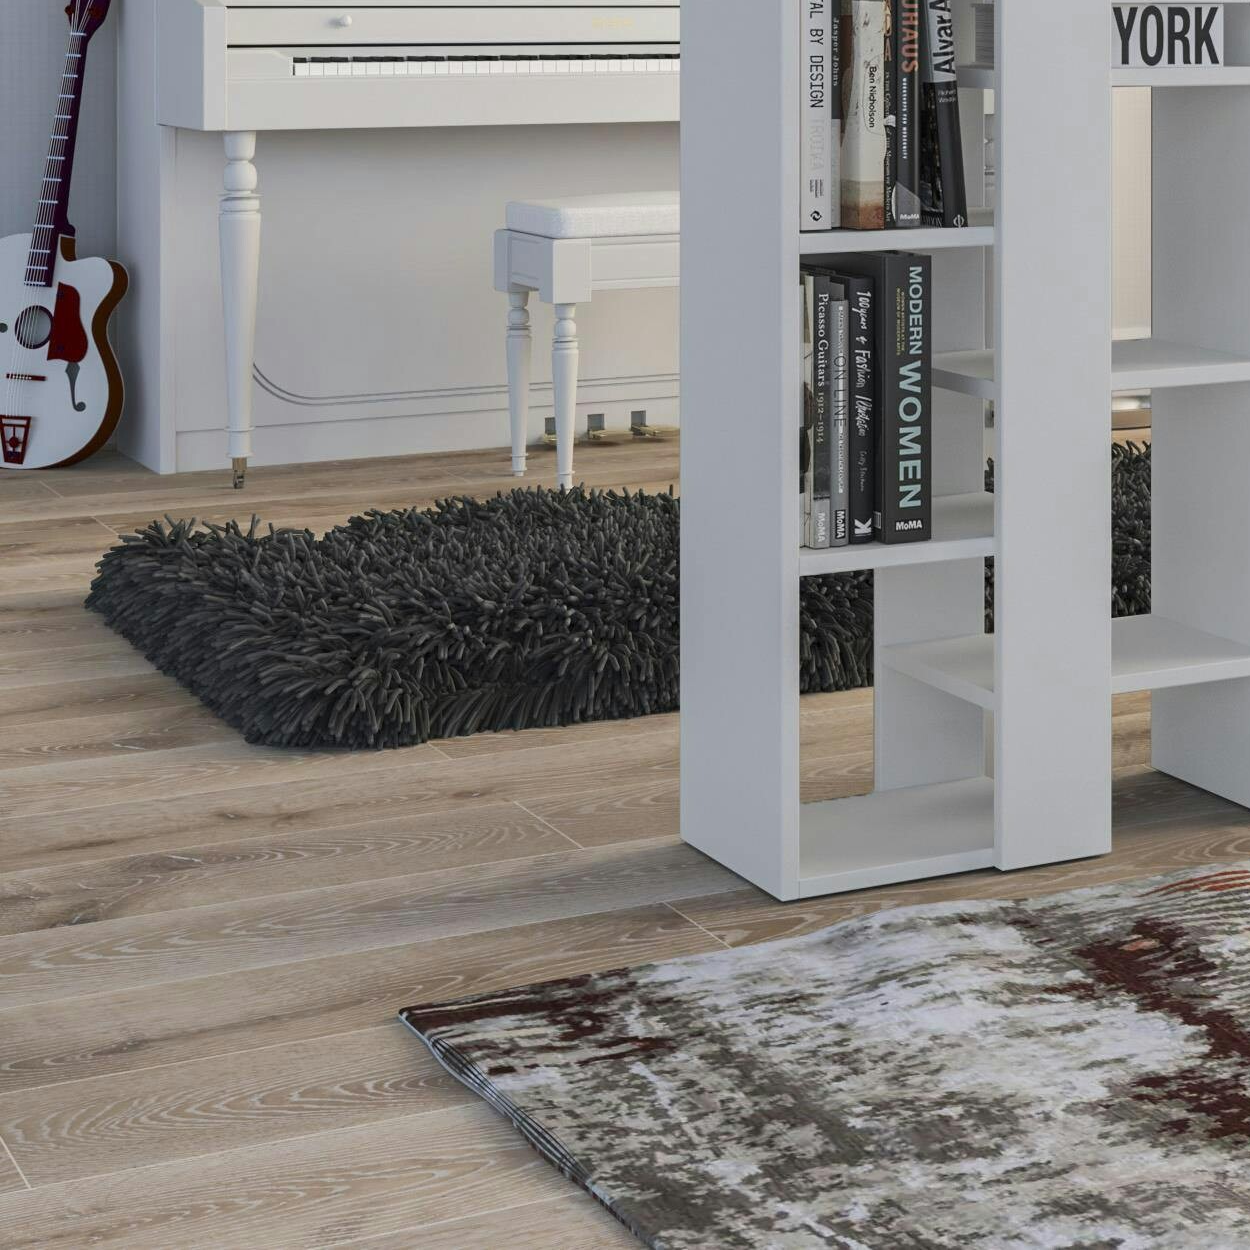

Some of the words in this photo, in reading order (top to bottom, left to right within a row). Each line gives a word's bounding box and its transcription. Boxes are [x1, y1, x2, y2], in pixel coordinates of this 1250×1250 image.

[809, 28, 824, 45] BY
[932, 15, 957, 75] Alvar
[1112, 5, 1220, 67] YORK
[809, 55, 824, 108] DESIGN
[869, 66, 877, 81] Ben
[869, 83, 877, 128] Nicholson
[818, 293, 829, 338] Picasso
[909, 266, 923, 355] MODERN
[817, 340, 829, 387] Guitars
[833, 355, 847, 381] ON
[855, 350, 871, 388] Fashion
[833, 389, 847, 429] LINE
[898, 360, 922, 508] WOMEN
[818, 512, 826, 543] MoMA
[836, 510, 846, 539] MoMA
[895, 520, 923, 531] MoMA
